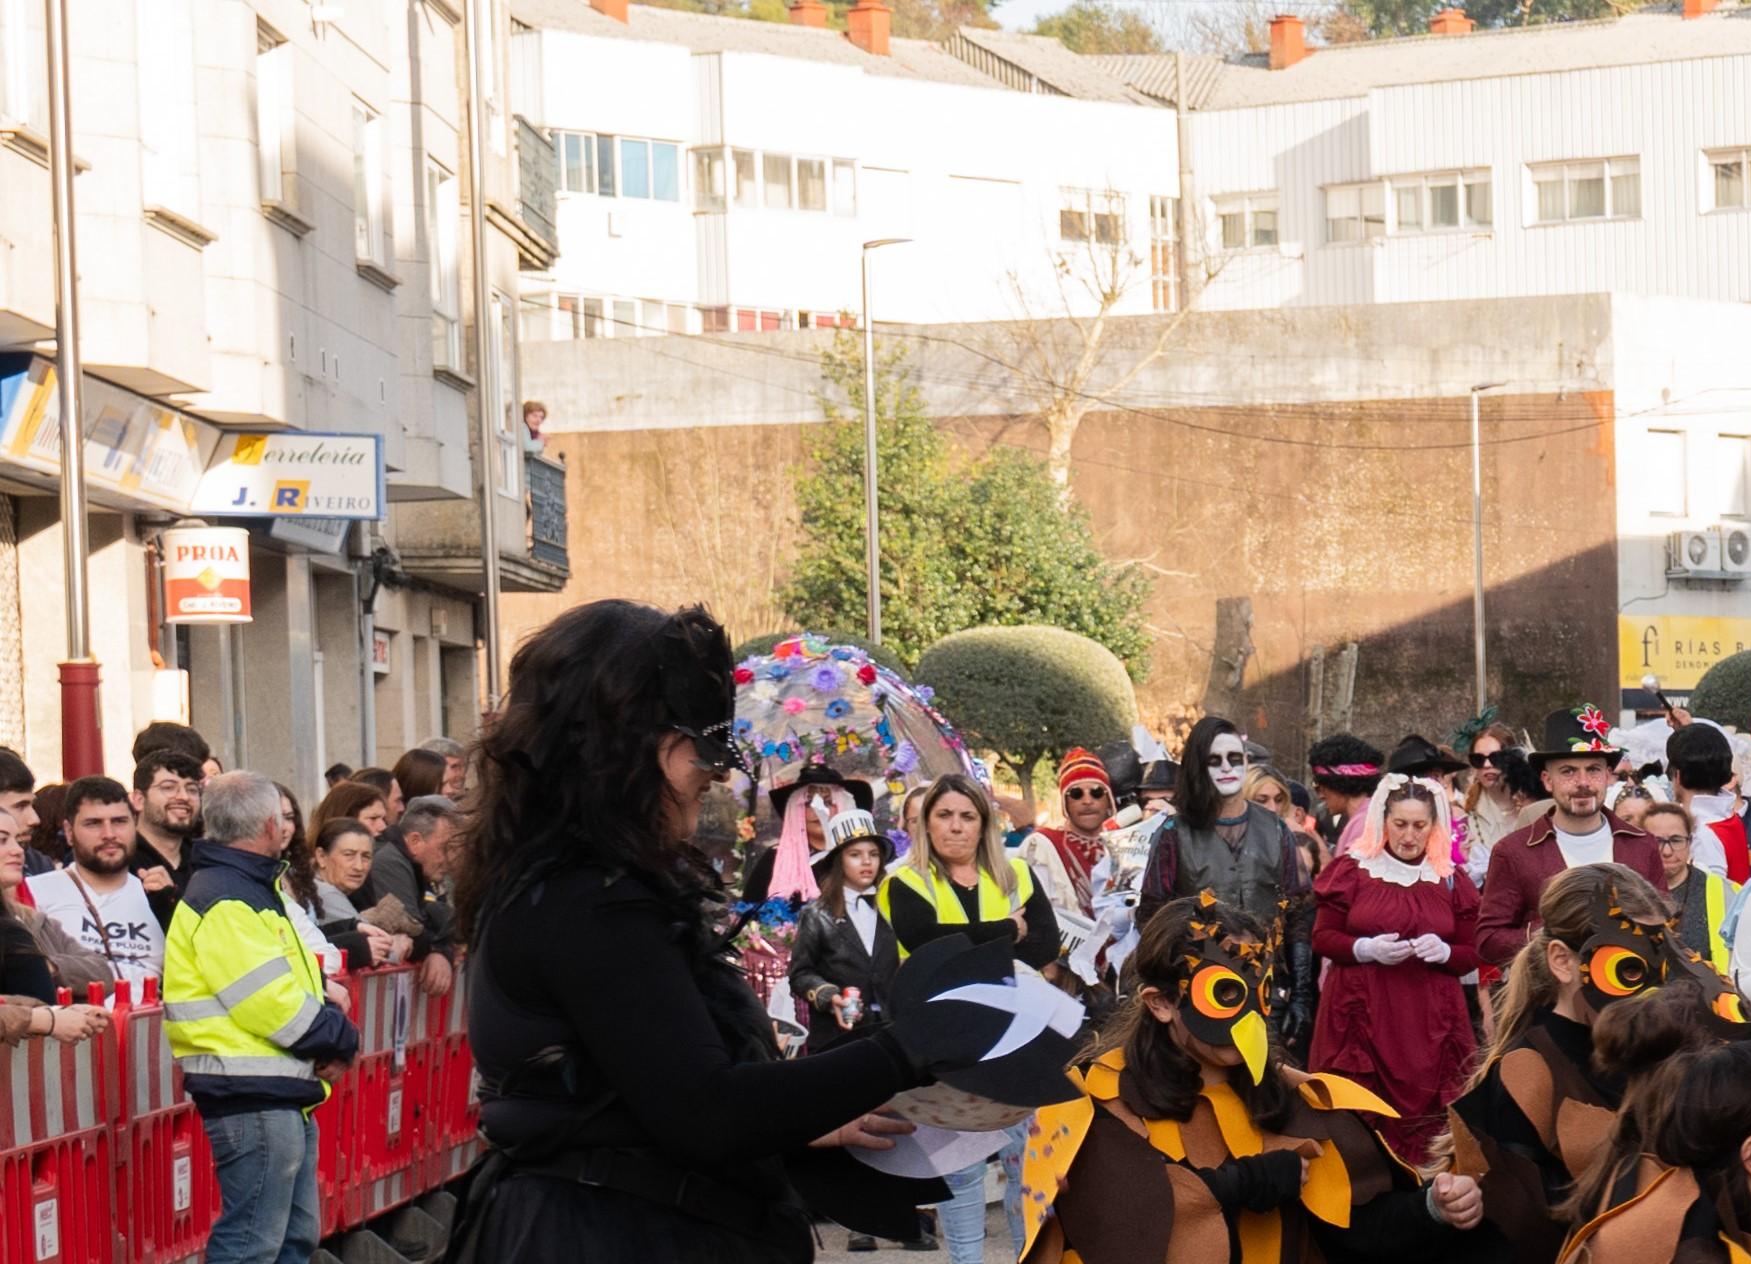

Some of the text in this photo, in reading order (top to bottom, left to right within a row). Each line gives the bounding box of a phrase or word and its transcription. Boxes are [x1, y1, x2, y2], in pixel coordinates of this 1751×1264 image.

[232, 487, 370, 510] J. RIVEIRO
[177, 546, 239, 562] PROA
[1675, 637, 1721, 655] RÍAS
[81, 916, 151, 942] NGK
[115, 942, 151, 952] PLUGS
